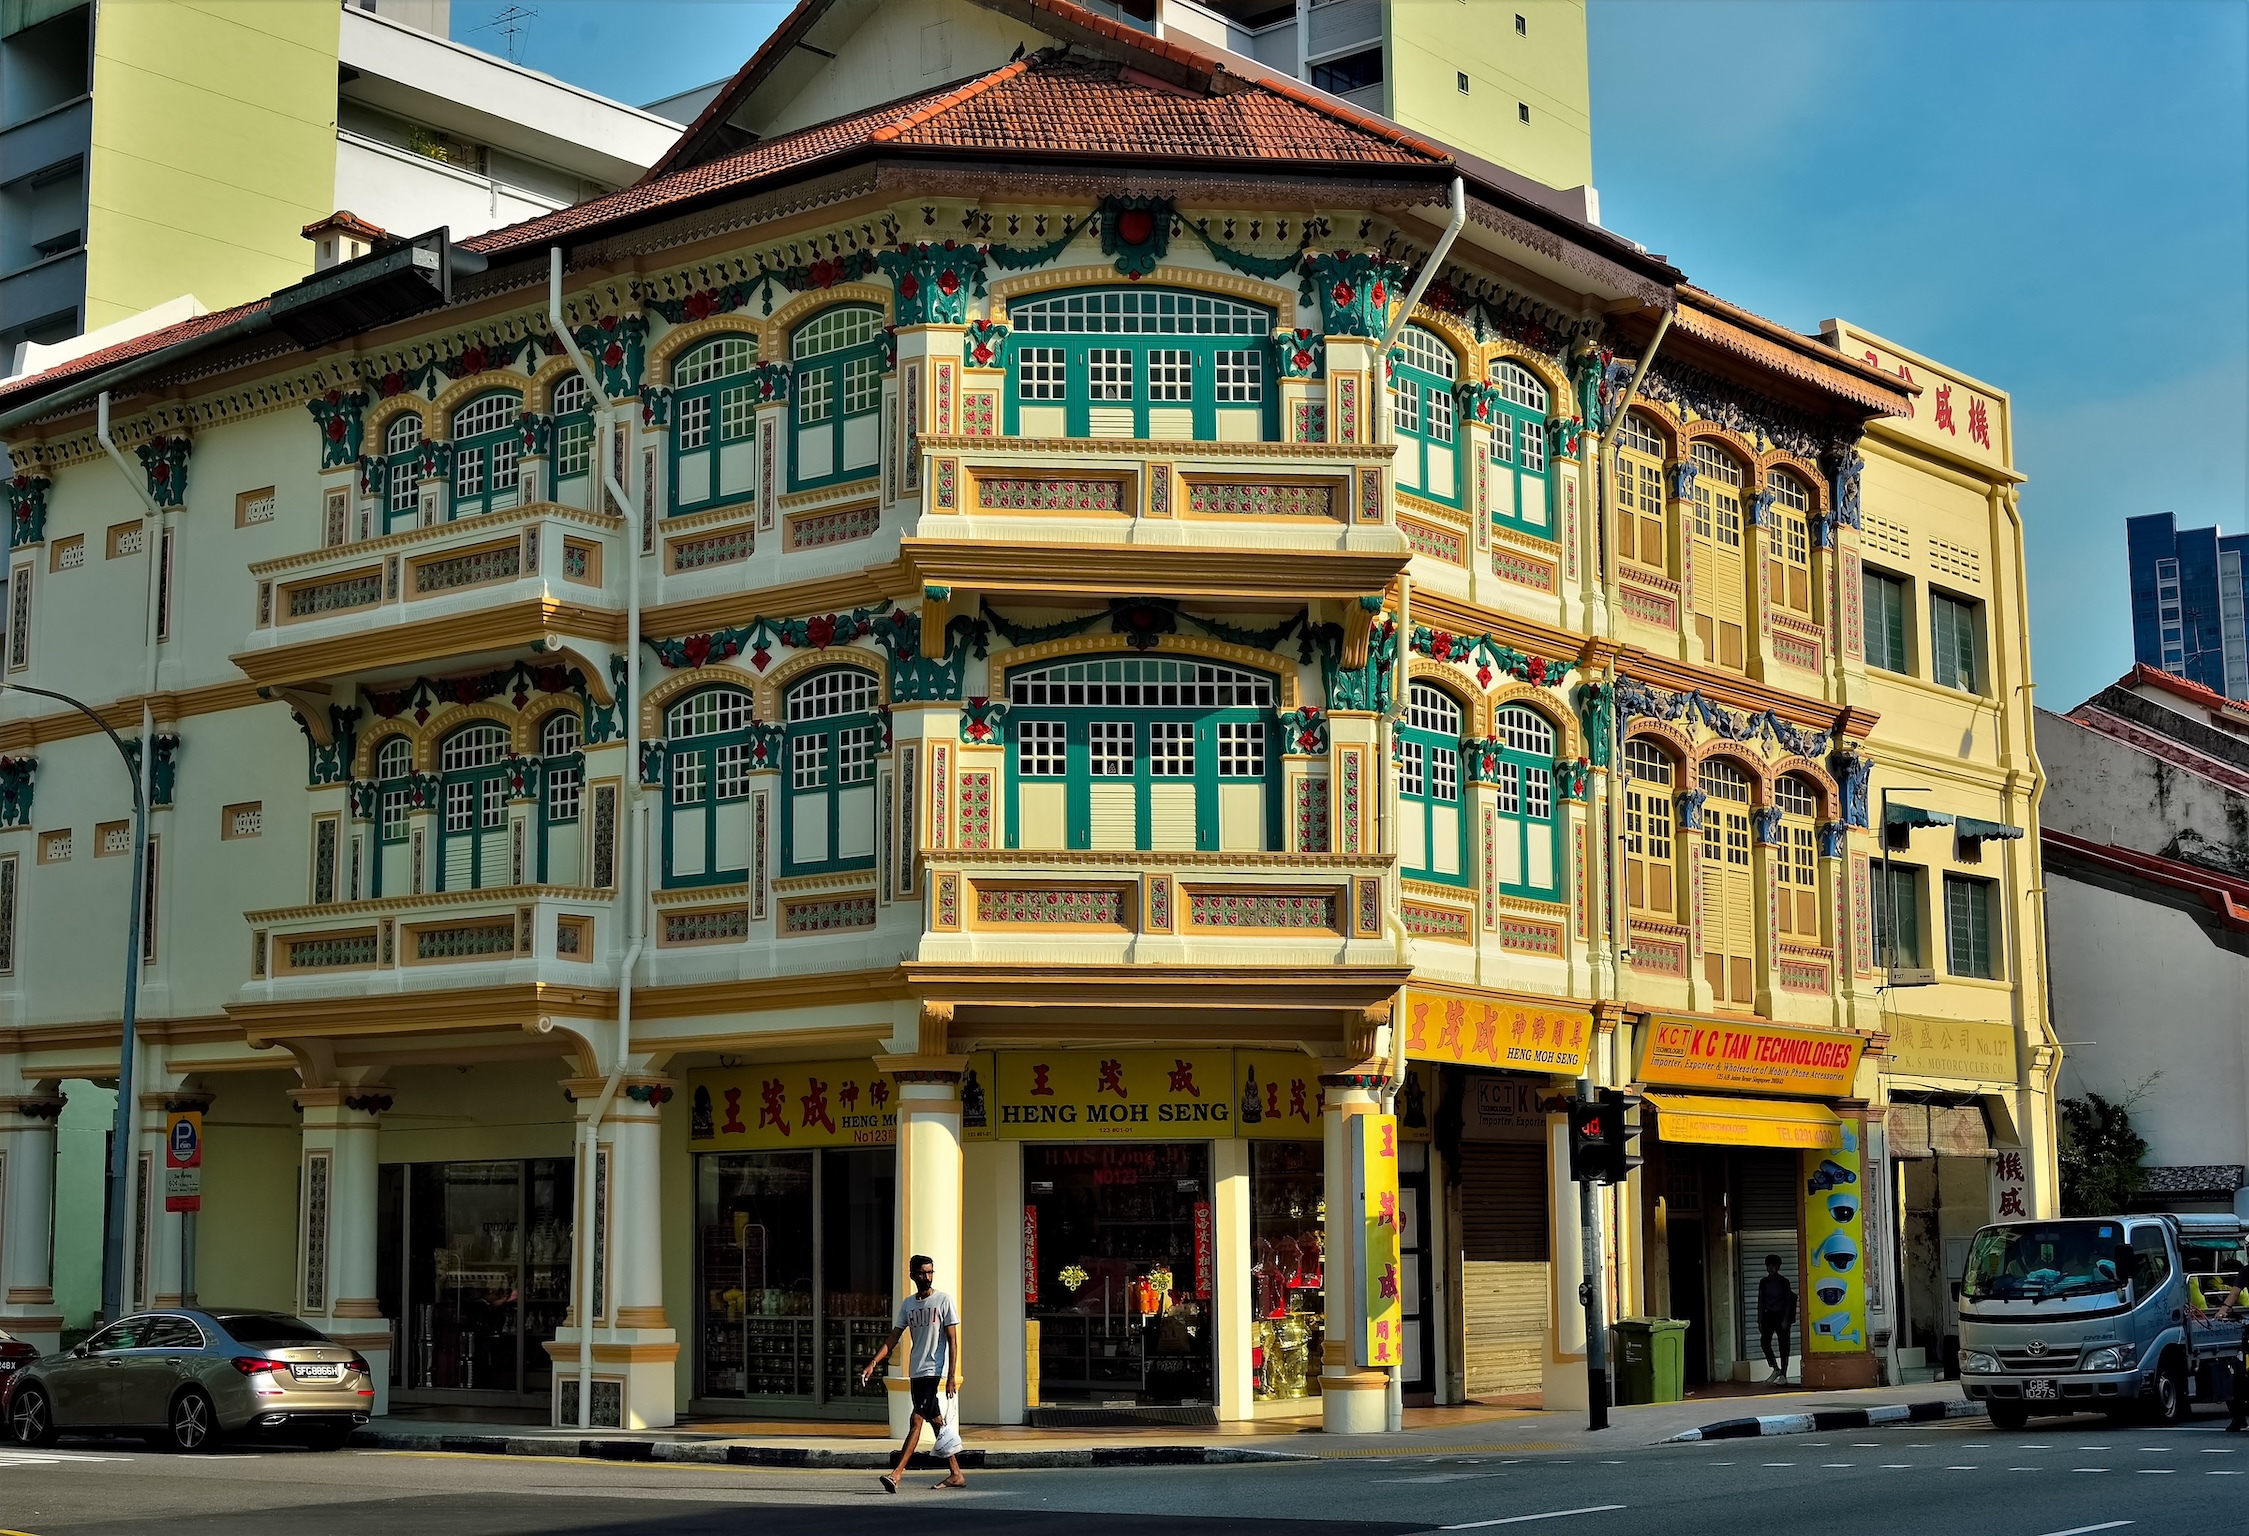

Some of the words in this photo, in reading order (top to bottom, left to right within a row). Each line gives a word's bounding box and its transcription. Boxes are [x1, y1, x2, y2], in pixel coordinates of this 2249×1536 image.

[1405, 999, 1500, 1063] 王茂成
[1900, 1022, 1971, 1053] 機盛公司
[1976, 1038, 1992, 1056] No.
[1994, 1040, 2008, 1057] 127
[1507, 1046, 1532, 1061] HENG
[1534, 1050, 1554, 1063] MOH
[1556, 1052, 1579, 1065] SENG
[1690, 1029, 1705, 1055] K
[1706, 1030, 1719, 1057] C
[1721, 1032, 1753, 1060] TAN
[1754, 1036, 1852, 1069] TECHNOLOGIES
[1650, 1056, 1682, 1068] Importer,
[1684, 1058, 1714, 1071] Exporter
[1715, 1061, 1721, 1070] &
[1723, 1062, 1759, 1074] Wholesaler
[1760, 1065, 1767, 1075] of
[1769, 1066, 1789, 1077] Mobile
[1790, 1068, 1810, 1079] Phone
[1810, 1070, 1845, 1081] Accessories
[1927, 1057, 1989, 1074] MOTORCYCLES
[1991, 1061, 2007, 1075] CO.
[1030, 1059, 1200, 1098] 王茂成
[721, 1078, 836, 1137] 王茂成
[1519, 1086, 1528, 1112] K
[842, 1115, 878, 1129] HENG
[1002, 1104, 1077, 1123] HENG
[1086, 1103, 1149, 1123] MOH
[1158, 1103, 1229, 1123] SENG
[1479, 1115, 1515, 1127] Importer,
[1776, 1126, 1793, 1141] TEL
[1794, 1128, 1813, 1142] 6291
[2025, 1389, 2056, 1399] 1027S
[2029, 1380, 2050, 1390] GBE
